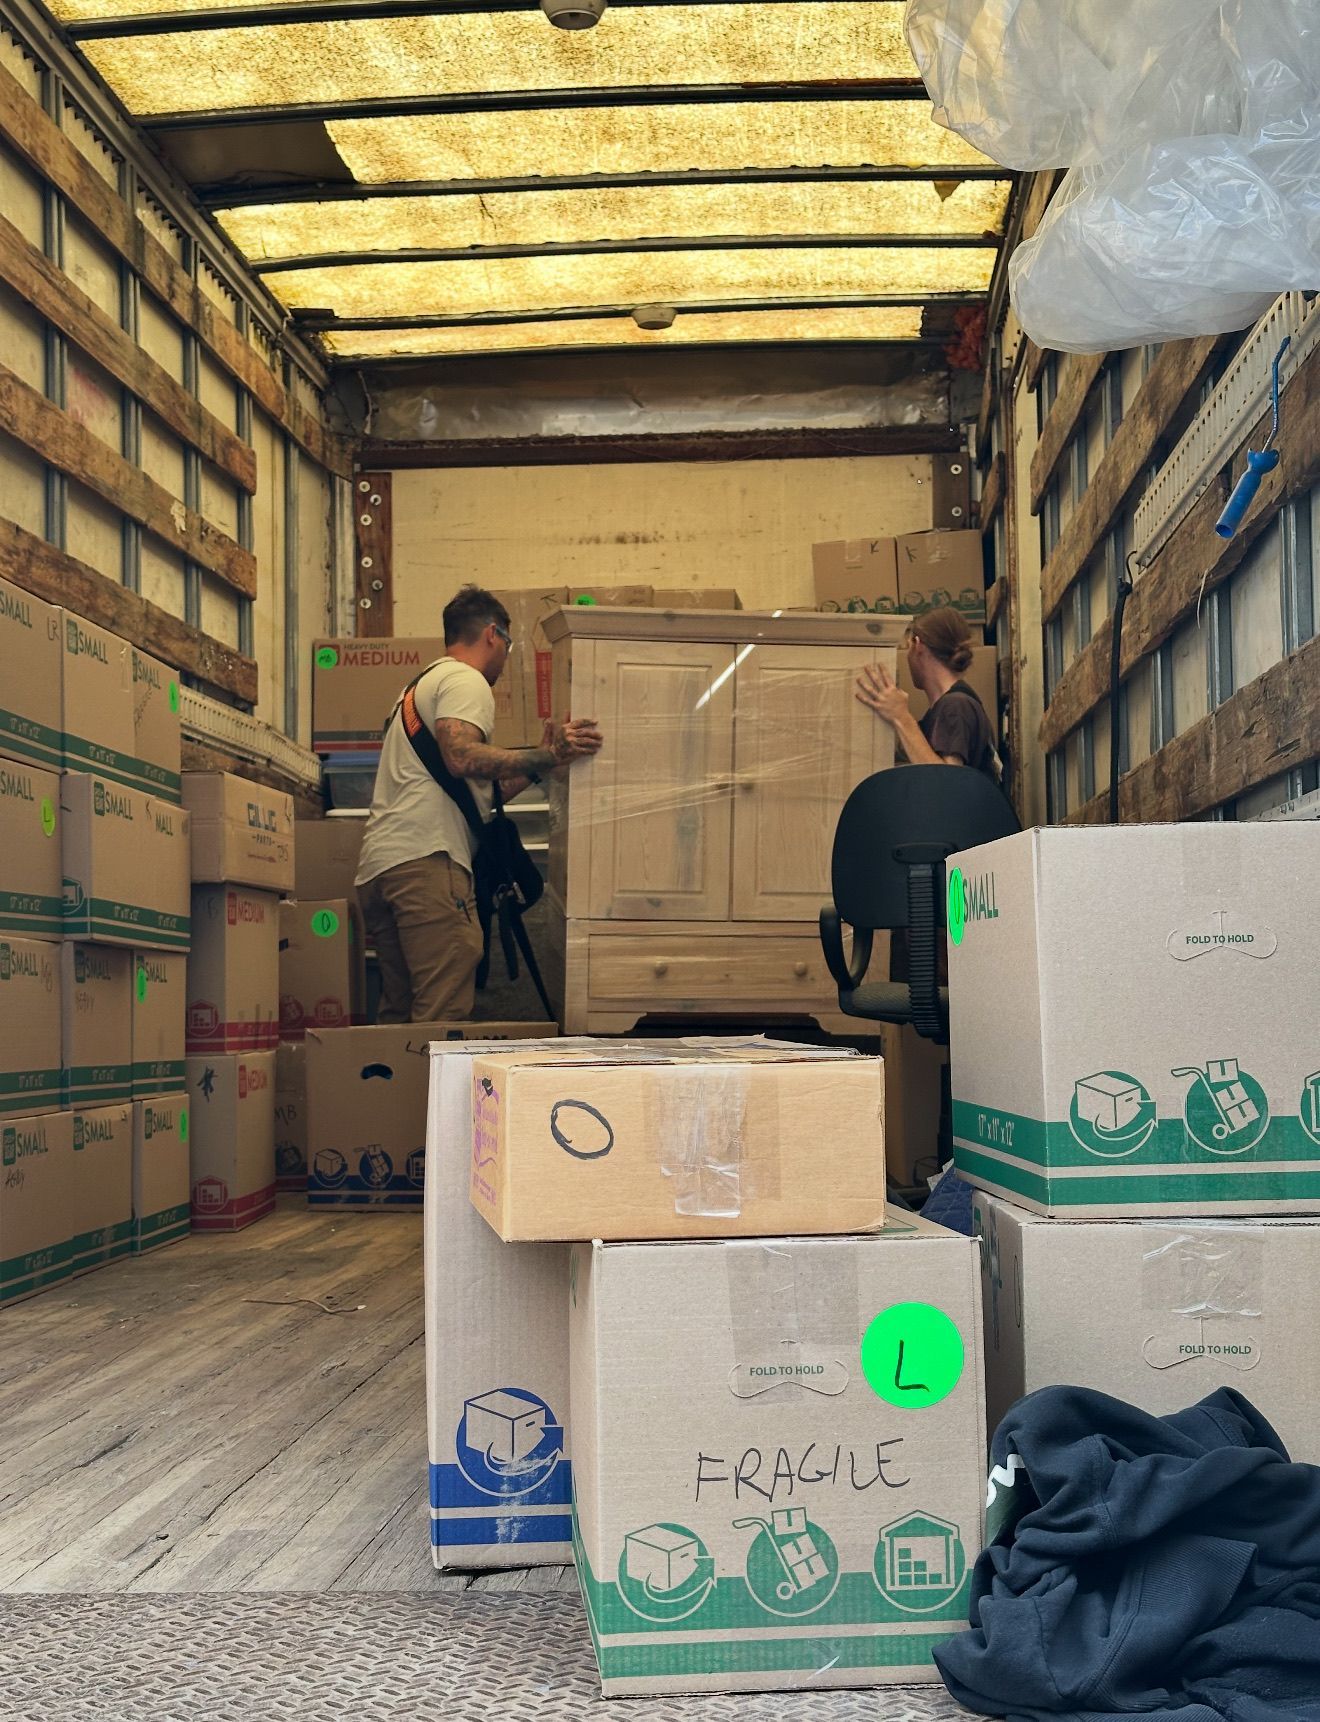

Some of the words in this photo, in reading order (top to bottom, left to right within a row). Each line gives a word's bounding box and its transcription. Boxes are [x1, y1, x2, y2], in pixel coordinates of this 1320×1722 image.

[78, 628, 109, 664] SMALL
[344, 651, 420, 666] MEDIUM
[137, 659, 161, 690] SMALL
[1, 770, 34, 801] SMALL
[105, 791, 133, 820] SMALL
[155, 813, 174, 836] MALL
[963, 871, 998, 923] SMALL
[238, 901, 265, 923] MEDIUM
[1185, 935, 1211, 944] FOLD
[1213, 935, 1226, 943] TO
[1227, 934, 1254, 943] HOLD
[12, 950, 38, 976] SMALL
[86, 955, 111, 981] SMALL
[146, 962, 168, 983] SMALL
[85, 1119, 114, 1143] SMALL
[153, 1110, 174, 1133] SMALL
[17, 1128, 49, 1157] SMALL
[1179, 1345, 1205, 1354] FOLD
[1207, 1345, 1221, 1354] TO
[1223, 1345, 1252, 1354] HOLD
[750, 1366, 777, 1376] FOLD
[779, 1366, 793, 1375] TO
[795, 1365, 825, 1375] HOLD
[895, 1340, 930, 1392] L
[696, 1438, 911, 1502] FRAGILE
